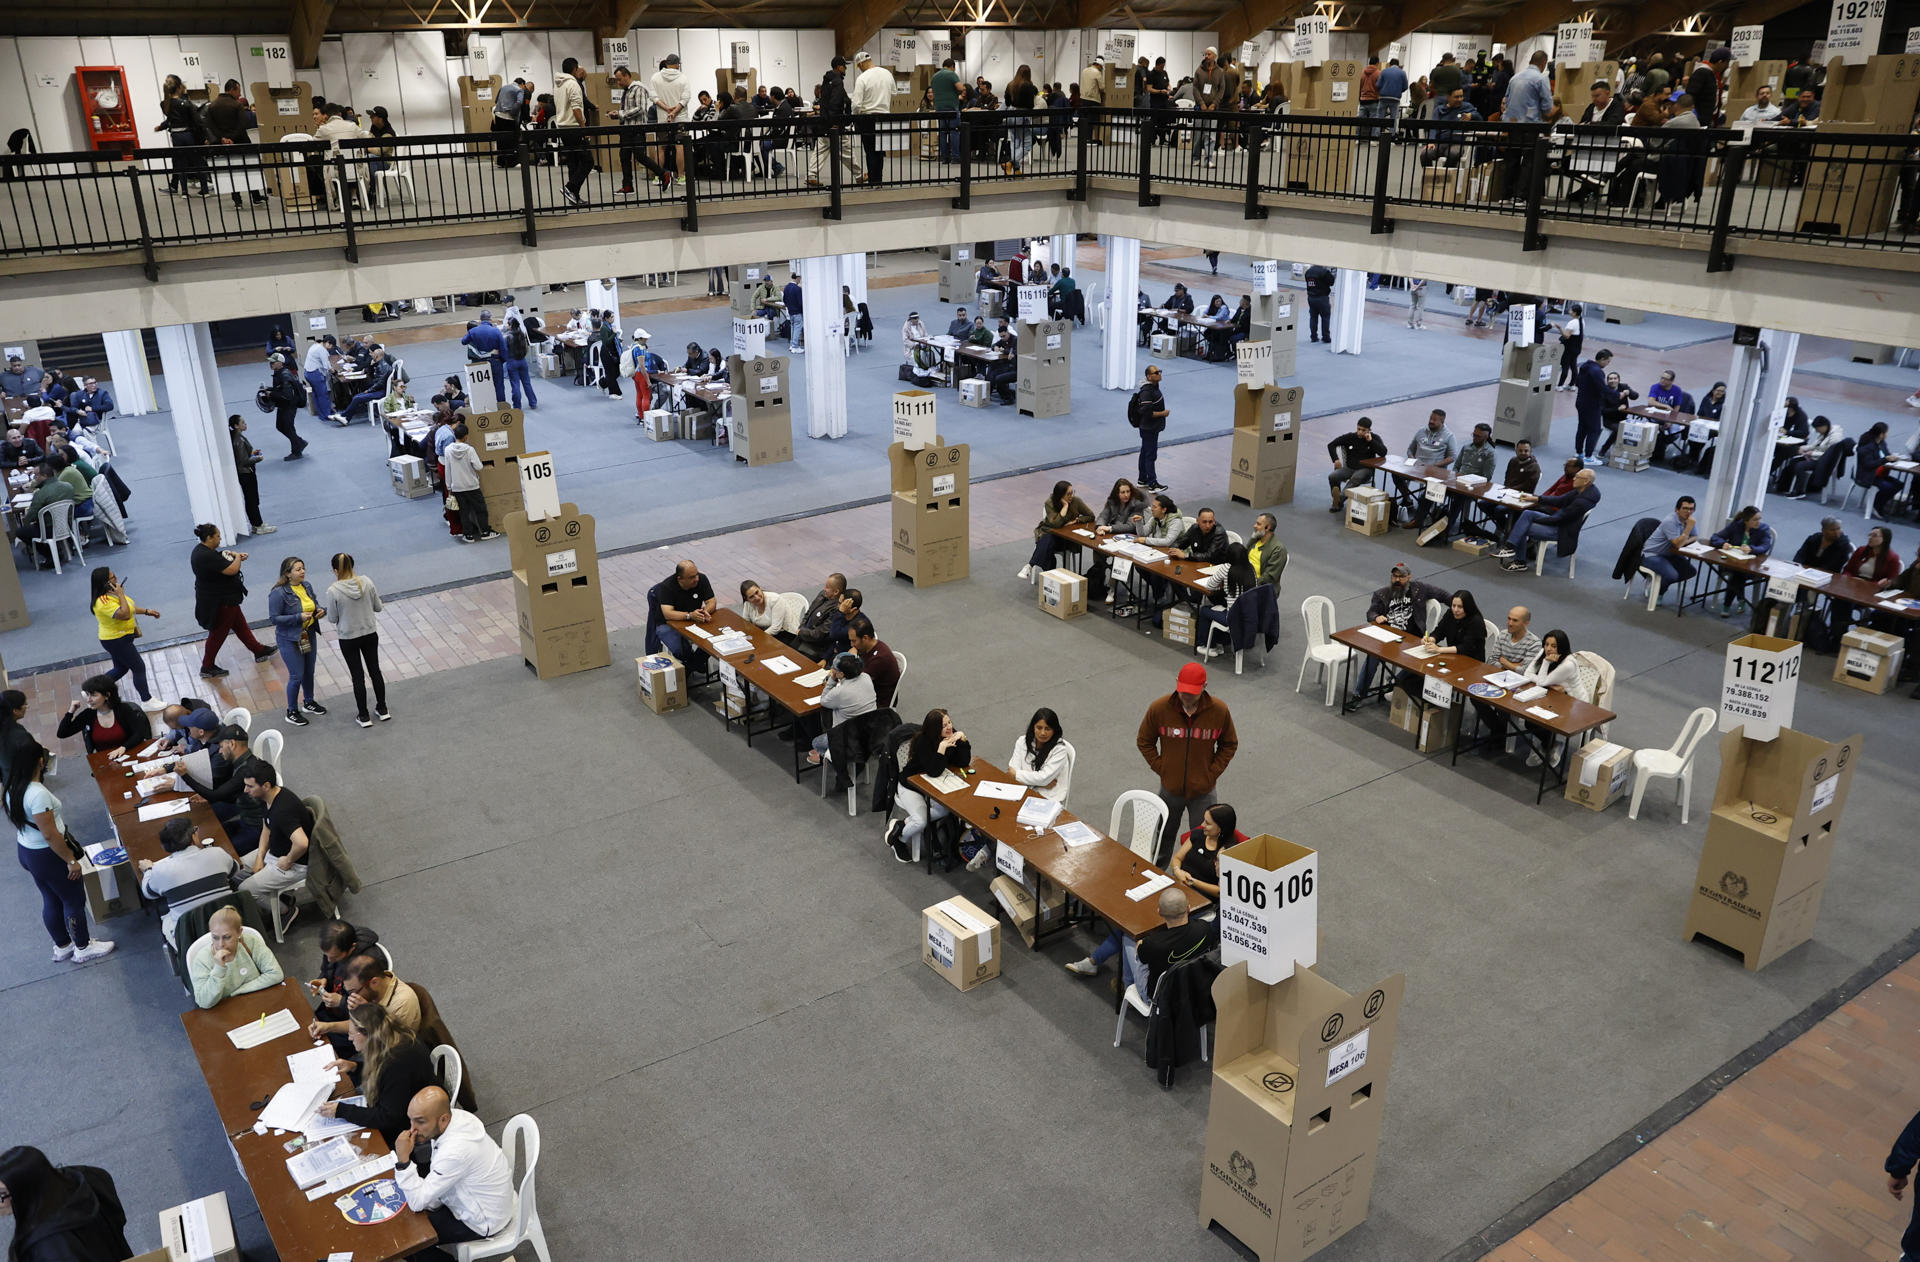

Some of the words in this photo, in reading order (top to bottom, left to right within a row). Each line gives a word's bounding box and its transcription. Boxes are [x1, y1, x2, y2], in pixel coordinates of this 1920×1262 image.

[1837, 1, 1869, 21] 192
[1870, 1, 1885, 18] 192
[1296, 22, 1312, 36] 191
[1314, 21, 1328, 34] 191
[1560, 28, 1578, 40] 197
[1580, 28, 1592, 39] 197
[1733, 30, 1752, 41] 203
[1909, 32, 1920, 41] 20
[611, 42, 627, 53] 186
[738, 45, 750, 54] 189
[903, 40, 916, 49] 190
[941, 43, 951, 51] 195
[1123, 40, 1135, 48] 196
[264, 47, 287, 60] 182
[474, 51, 485, 60] 185
[183, 56, 200, 67] 181
[1254, 265, 1265, 273] 122
[1266, 264, 1277, 272] 122
[1019, 290, 1032, 300] 116
[1034, 289, 1047, 299] 116
[1510, 311, 1524, 321] 123
[1525, 311, 1534, 320] 123
[735, 322, 745, 334] 110
[748, 323, 764, 334] 110
[1237, 348, 1252, 359] 117
[1255, 346, 1272, 359] 117
[470, 369, 491, 384] 104
[895, 400, 911, 416] 111
[915, 401, 933, 416] 111
[524, 462, 552, 481] 105
[549, 563, 564, 571] MESA
[1733, 656, 1776, 684] 112
[1778, 656, 1799, 682] 112
[1424, 690, 1438, 699] MESA
[1439, 695, 1450, 704] 112
[1726, 687, 1770, 702] 79.388.152
[1723, 703, 1767, 719] 79.478.839
[997, 857, 1012, 870] MESA
[1222, 870, 1266, 910] 106
[1274, 869, 1313, 910] 106
[1222, 909, 1267, 934] 53.047.539
[929, 933, 942, 948] MESA
[1222, 930, 1267, 955] 53.056.298
[1329, 1060, 1349, 1078] MESA
[1351, 1050, 1365, 1065] 106
